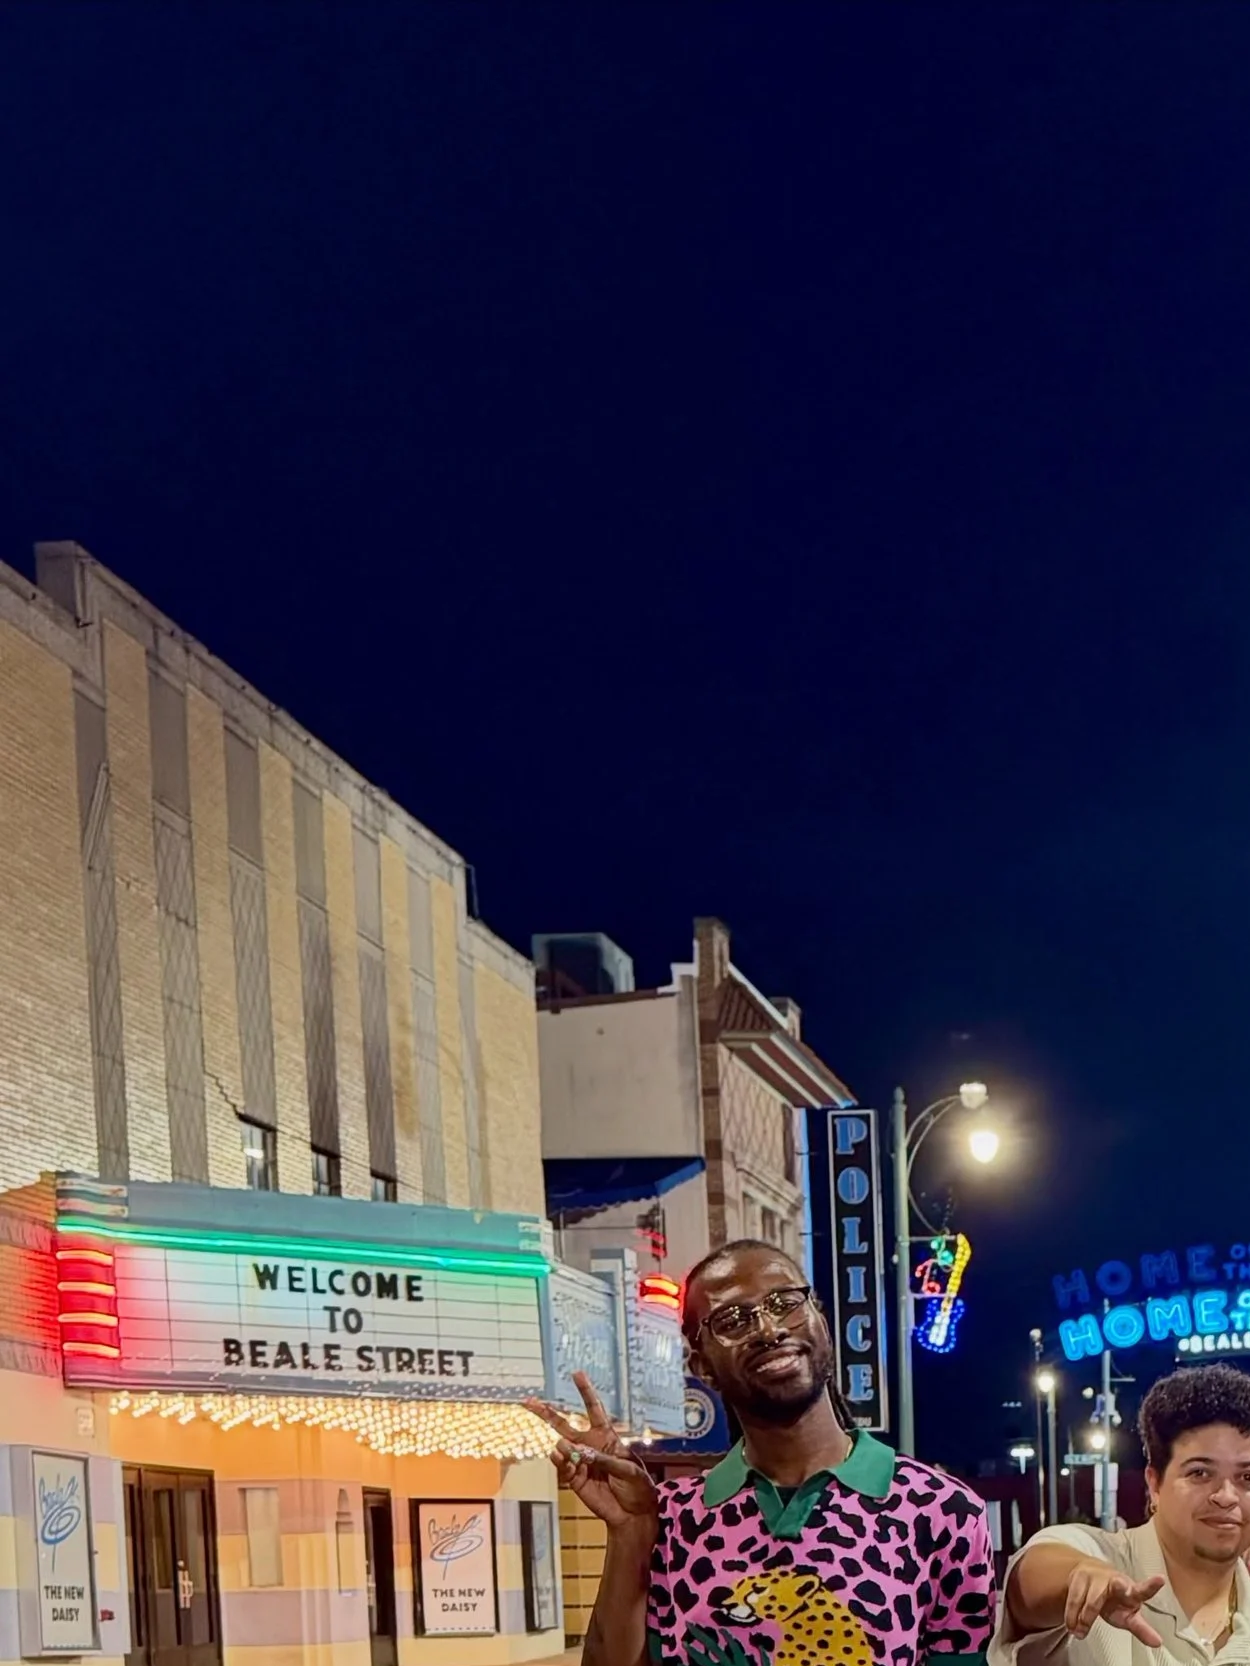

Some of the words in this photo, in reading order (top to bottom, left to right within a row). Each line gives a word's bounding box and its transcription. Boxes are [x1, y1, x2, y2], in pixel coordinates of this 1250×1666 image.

[833, 1117, 875, 1402] POLICE
[252, 1263, 424, 1302] WELCOME
[323, 1306, 363, 1335] TO
[1059, 1290, 1229, 1361] HOME
[223, 1338, 344, 1371] BEALE
[356, 1345, 474, 1377] STREET
[44, 1585, 62, 1600] THE
[64, 1586, 85, 1600] NEW
[432, 1588, 455, 1598] THE
[458, 1588, 486, 1598] NEW
[441, 1602, 478, 1612] DAISY
[52, 1607, 80, 1622] DAISY
